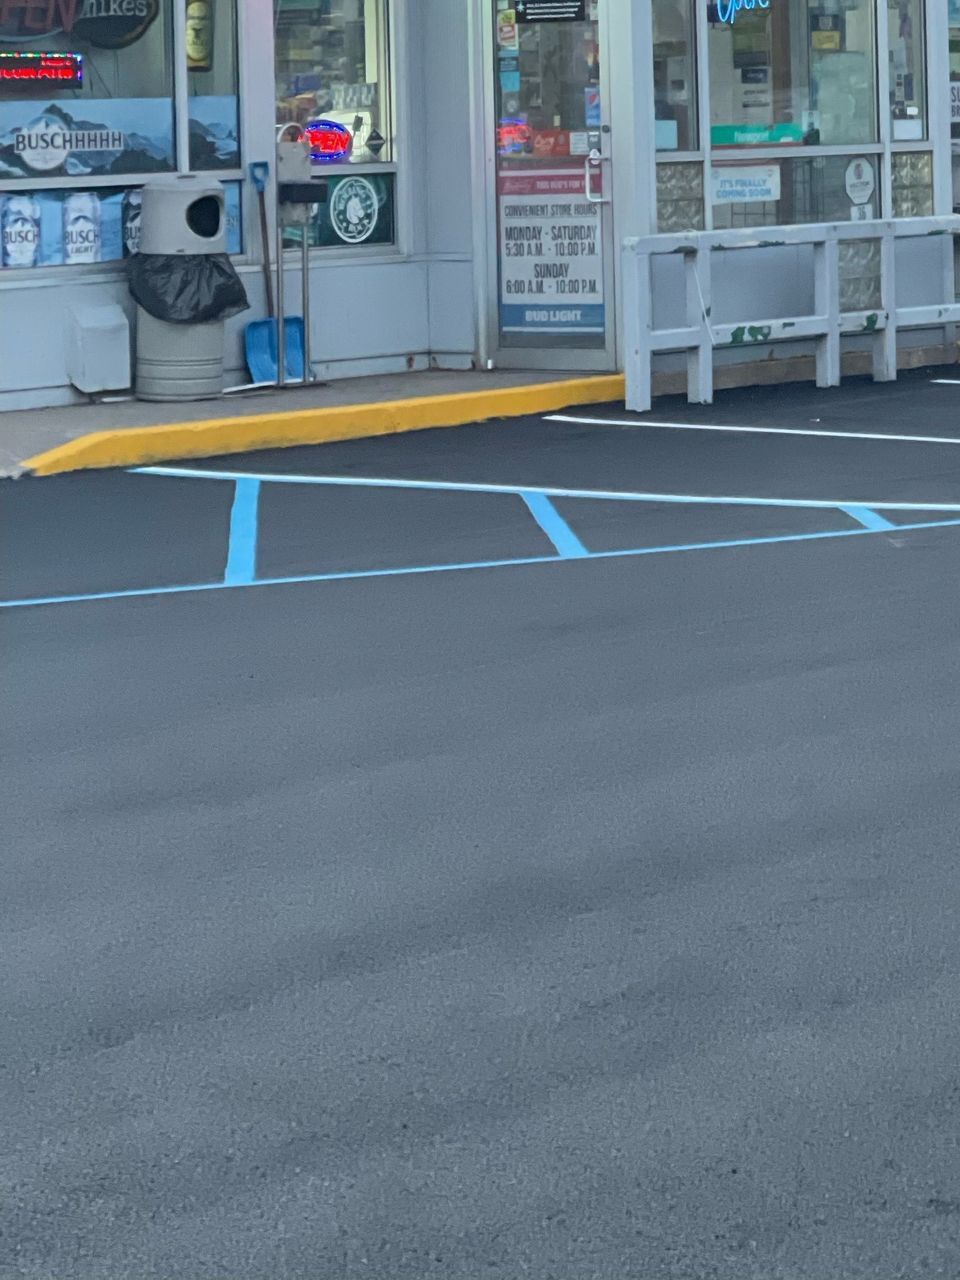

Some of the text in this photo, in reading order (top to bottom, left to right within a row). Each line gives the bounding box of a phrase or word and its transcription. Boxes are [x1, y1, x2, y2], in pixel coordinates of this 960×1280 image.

[15, 131, 122, 152] BUSCHHHHH
[550, 204, 573, 217] STORE
[574, 203, 598, 216] HOURS
[505, 226, 543, 241] MONDAY
[551, 225, 597, 240] SATURDAY
[505, 243, 525, 257] 5:30
[526, 243, 545, 256] A.M.
[554, 242, 579, 257] 10:00
[581, 242, 598, 256] P.M.
[534, 263, 569, 278] SUNDAY
[506, 280, 525, 294] 6:00
[527, 280, 546, 294] A.M.
[555, 279, 579, 294] 10:00
[581, 279, 598, 294] P.M.
[525, 310, 583, 322] BUD LIGHT
